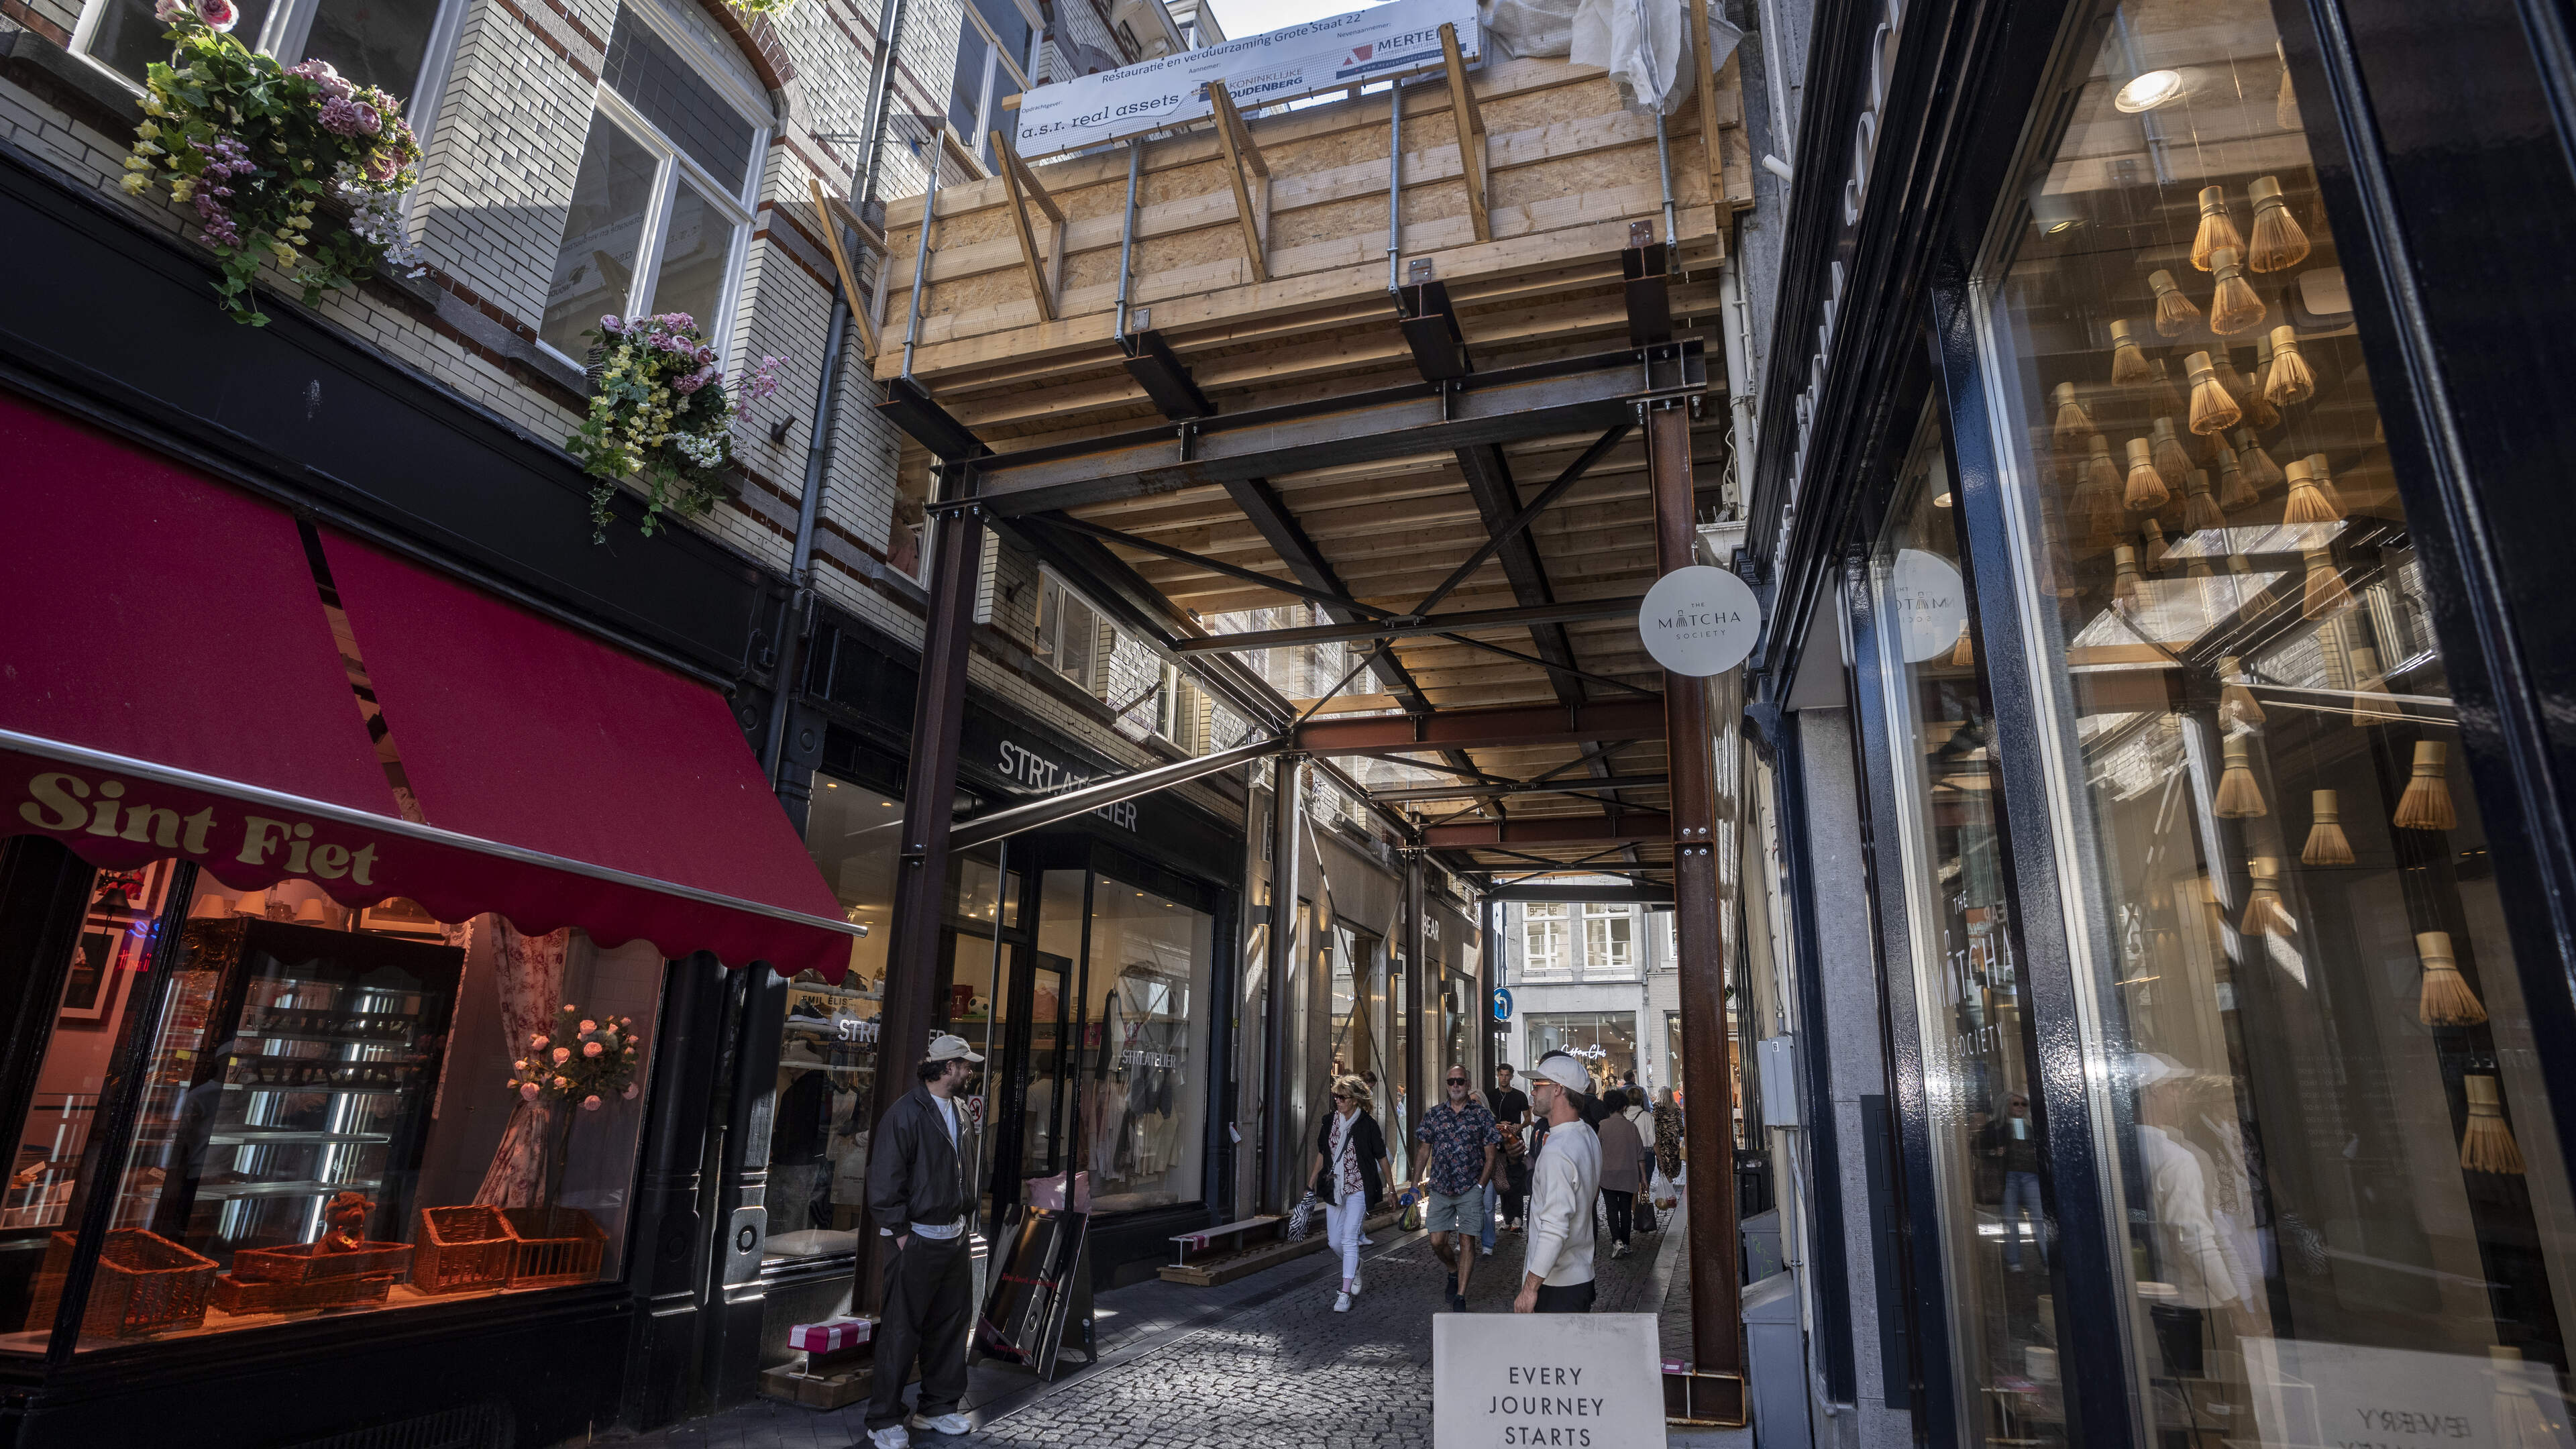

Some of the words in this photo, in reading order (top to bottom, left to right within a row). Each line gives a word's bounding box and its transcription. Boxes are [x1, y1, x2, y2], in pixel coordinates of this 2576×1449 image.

[1337, 22, 1391, 38] Nevenaannemer:
[1378, 23, 1458, 52] MERTES
[1102, 62, 1163, 84] Restauratie
[1167, 58, 1180, 67] en
[1184, 37, 1271, 62] verduurzaming
[1275, 27, 1308, 42] Grote
[1311, 19, 1342, 33] Staat
[1346, 13, 1361, 23] 22
[1189, 62, 1222, 74] Aannemer:
[1229, 76, 1303, 100] OUDENBERG
[1230, 68, 1303, 89] KONINKLIJKE
[1021, 122, 1065, 139] a.s.r.
[1071, 107, 1109, 128] real
[1116, 93, 1179, 117] assets
[1022, 101, 1063, 114] Opdrachtgever:
[1658, 610, 1741, 629] MATCHA
[1676, 630, 1726, 640] SOCIETY
[19, 772, 217, 854] Sint
[235, 815, 378, 885] Fiet
[1953, 890, 1968, 915] THE
[1953, 1022, 2002, 1059] SOCIETY
[1122, 1049, 1176, 1068] STRT.ATELIER
[1509, 1366, 1582, 1385] EVERY
[1489, 1396, 1604, 1416] JOURNEY
[1505, 1427, 1591, 1447] STARTS
